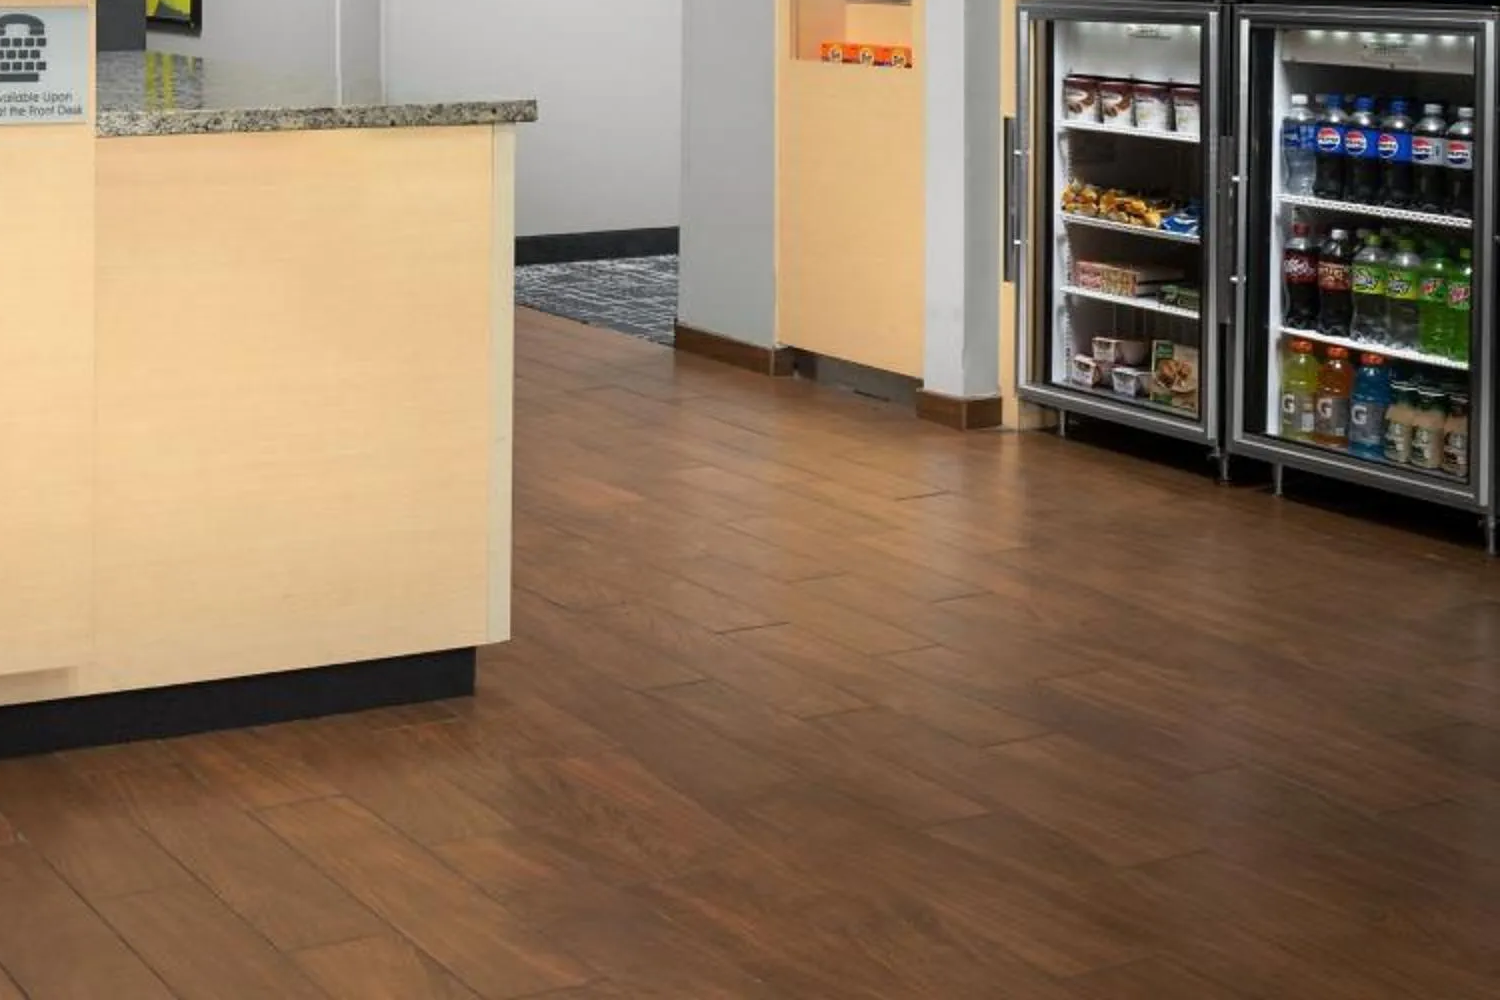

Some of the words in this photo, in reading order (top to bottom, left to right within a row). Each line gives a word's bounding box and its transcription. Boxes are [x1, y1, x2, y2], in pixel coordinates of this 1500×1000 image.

[43, 91, 74, 105] Upon
[1283, 393, 1296, 414] G
[1317, 397, 1333, 419] G
[1351, 404, 1368, 425] G
